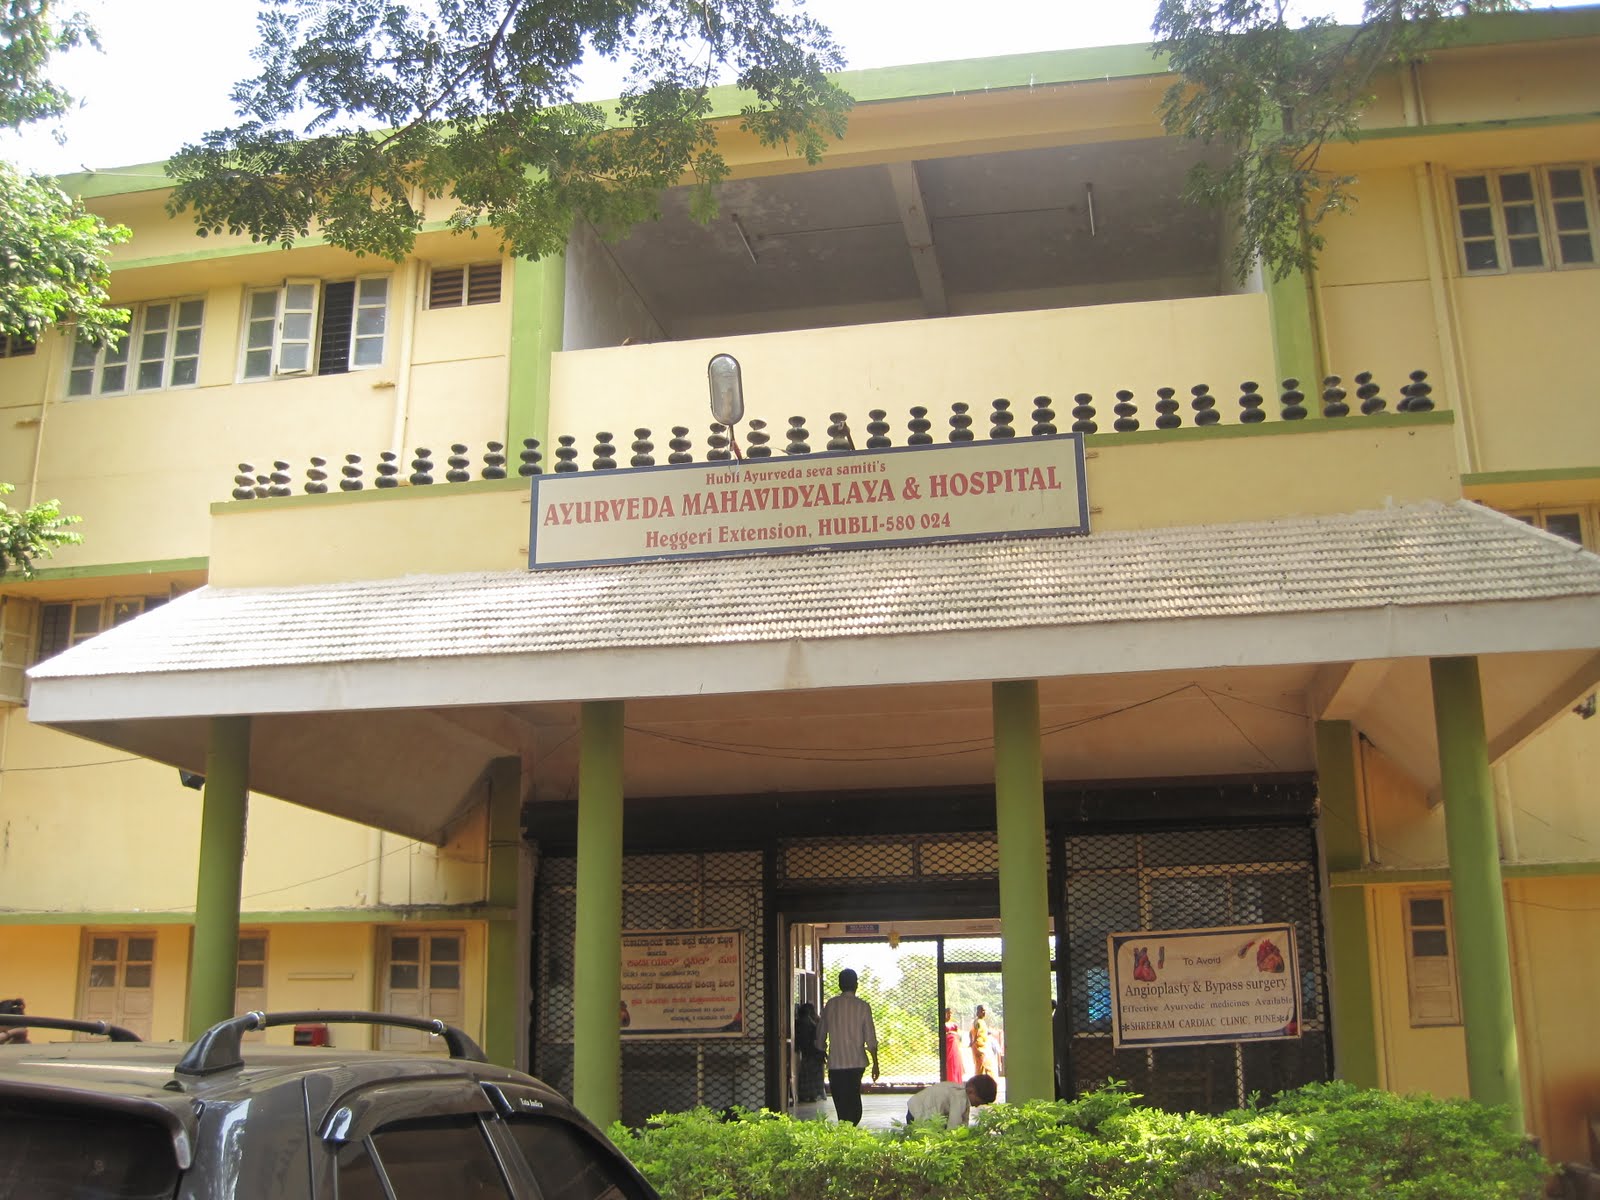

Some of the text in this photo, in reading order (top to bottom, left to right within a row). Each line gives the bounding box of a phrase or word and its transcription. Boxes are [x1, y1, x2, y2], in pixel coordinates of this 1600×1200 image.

[706, 461, 886, 485] Hubli Ayurveda seva samiti's
[543, 466, 1062, 526] AYURVEDA MAHAVIDYALAYA & HOSPITAL
[645, 512, 950, 550] Heggeri Extension, HUBLI-580 024
[1184, 957, 1221, 966] To Avoid
[1125, 978, 1287, 998] Angioplasty & Bypass surgery
[1122, 996, 1293, 1013] Effective Ayurvedic medicines Available
[1130, 1019, 1175, 1031] SHREERAM
[1179, 1017, 1217, 1028] CARDIAC
[1254, 1014, 1277, 1024] PUNE
